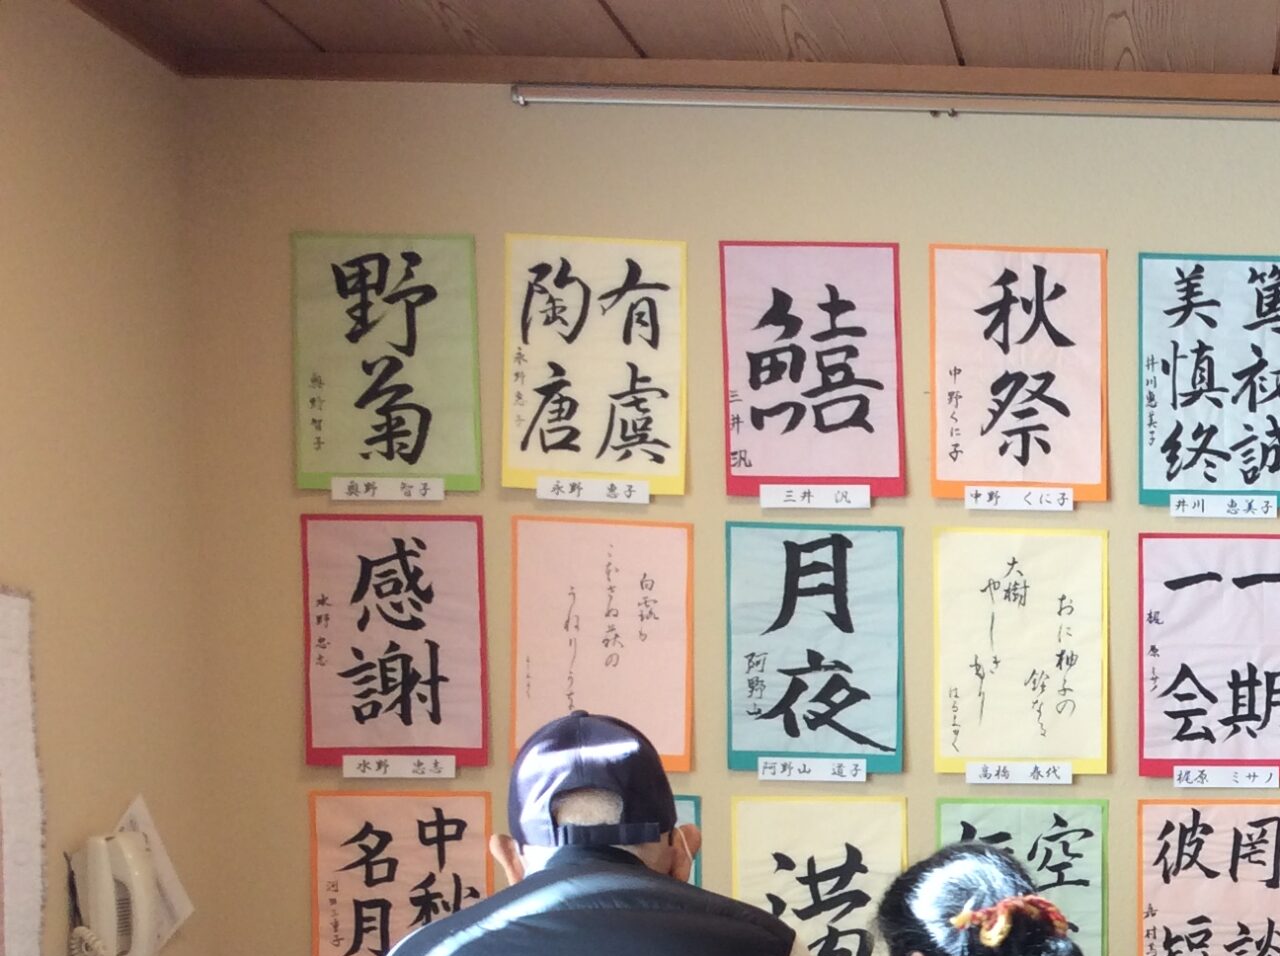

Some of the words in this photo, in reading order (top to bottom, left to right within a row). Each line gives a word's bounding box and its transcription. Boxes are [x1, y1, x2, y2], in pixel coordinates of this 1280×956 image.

[331, 250, 438, 464] 野菊
[520, 258, 592, 454] 陶唐
[596, 258, 670, 464] 有虞
[975, 264, 1076, 467] 秋祭
[947, 366, 964, 462] 中野くに子
[401, 482, 431, 498] 智子
[783, 490, 814, 505] 三井
[970, 490, 1000, 507] 中野
[1023, 489, 1069, 507] くに子
[1174, 497, 1206, 514] 井川
[1226, 499, 1273, 516] 恵美子
[1003, 557, 1030, 607] 大樹
[337, 537, 449, 727] 感謝
[761, 533, 896, 752] 月夜
[1157, 571, 1223, 742] 一会
[356, 759, 389, 776] 水野
[411, 760, 444, 776] 忠志
[763, 760, 812, 777] 阿野山
[831, 761, 864, 778] 道子
[978, 765, 1009, 782] 高橋
[1030, 764, 1061, 781] 春代
[1176, 767, 1208, 785] 梶原
[1232, 768, 1275, 784] ミサノ
[408, 807, 480, 928] 中秋
